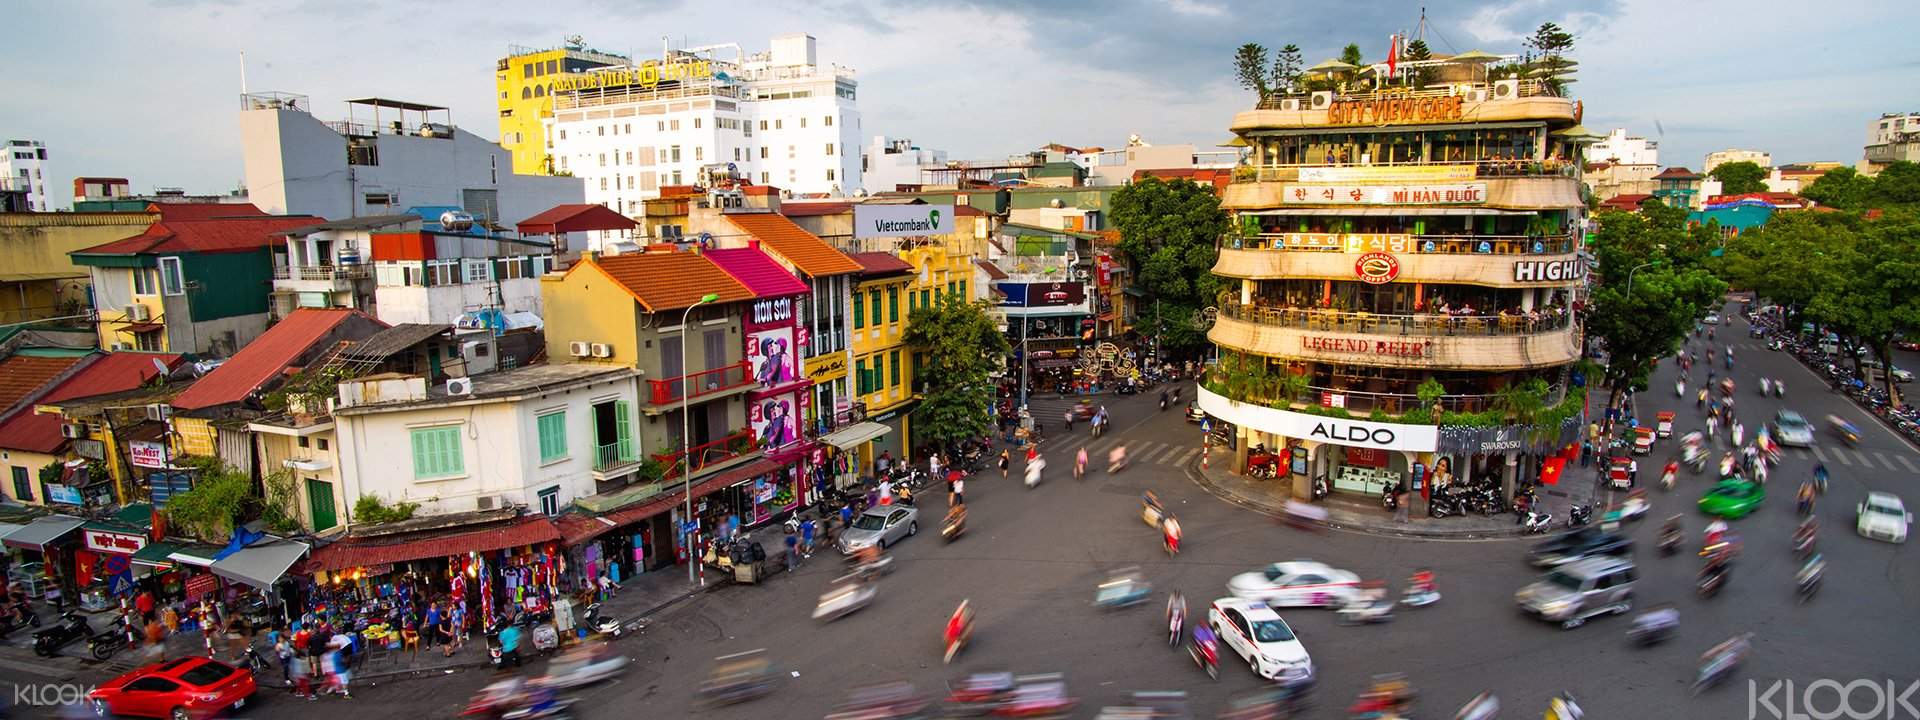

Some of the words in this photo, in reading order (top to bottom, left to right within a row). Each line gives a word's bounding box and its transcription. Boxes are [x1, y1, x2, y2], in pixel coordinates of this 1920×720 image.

[554, 77, 578, 91] MAY
[582, 74, 597, 88] DE
[601, 70, 633, 86] VILLE
[665, 61, 711, 80] HOTEL
[1328, 101, 1365, 124] CITY
[1371, 97, 1415, 122] VIEW
[1418, 95, 1462, 119] CAFE
[1393, 187, 1409, 203] MÌ
[1413, 186, 1440, 203] HÀN
[1446, 186, 1480, 201] QUỐC
[875, 218, 930, 232] Vietcombank
[1357, 252, 1397, 267] HIGHLANDS
[1361, 273, 1392, 283] COFFEE
[1303, 336, 1369, 353] LEGEND
[1375, 340, 1423, 356] BEER
[1311, 422, 1395, 444] ALDO
[1480, 440, 1521, 450] SWAROVSKI
